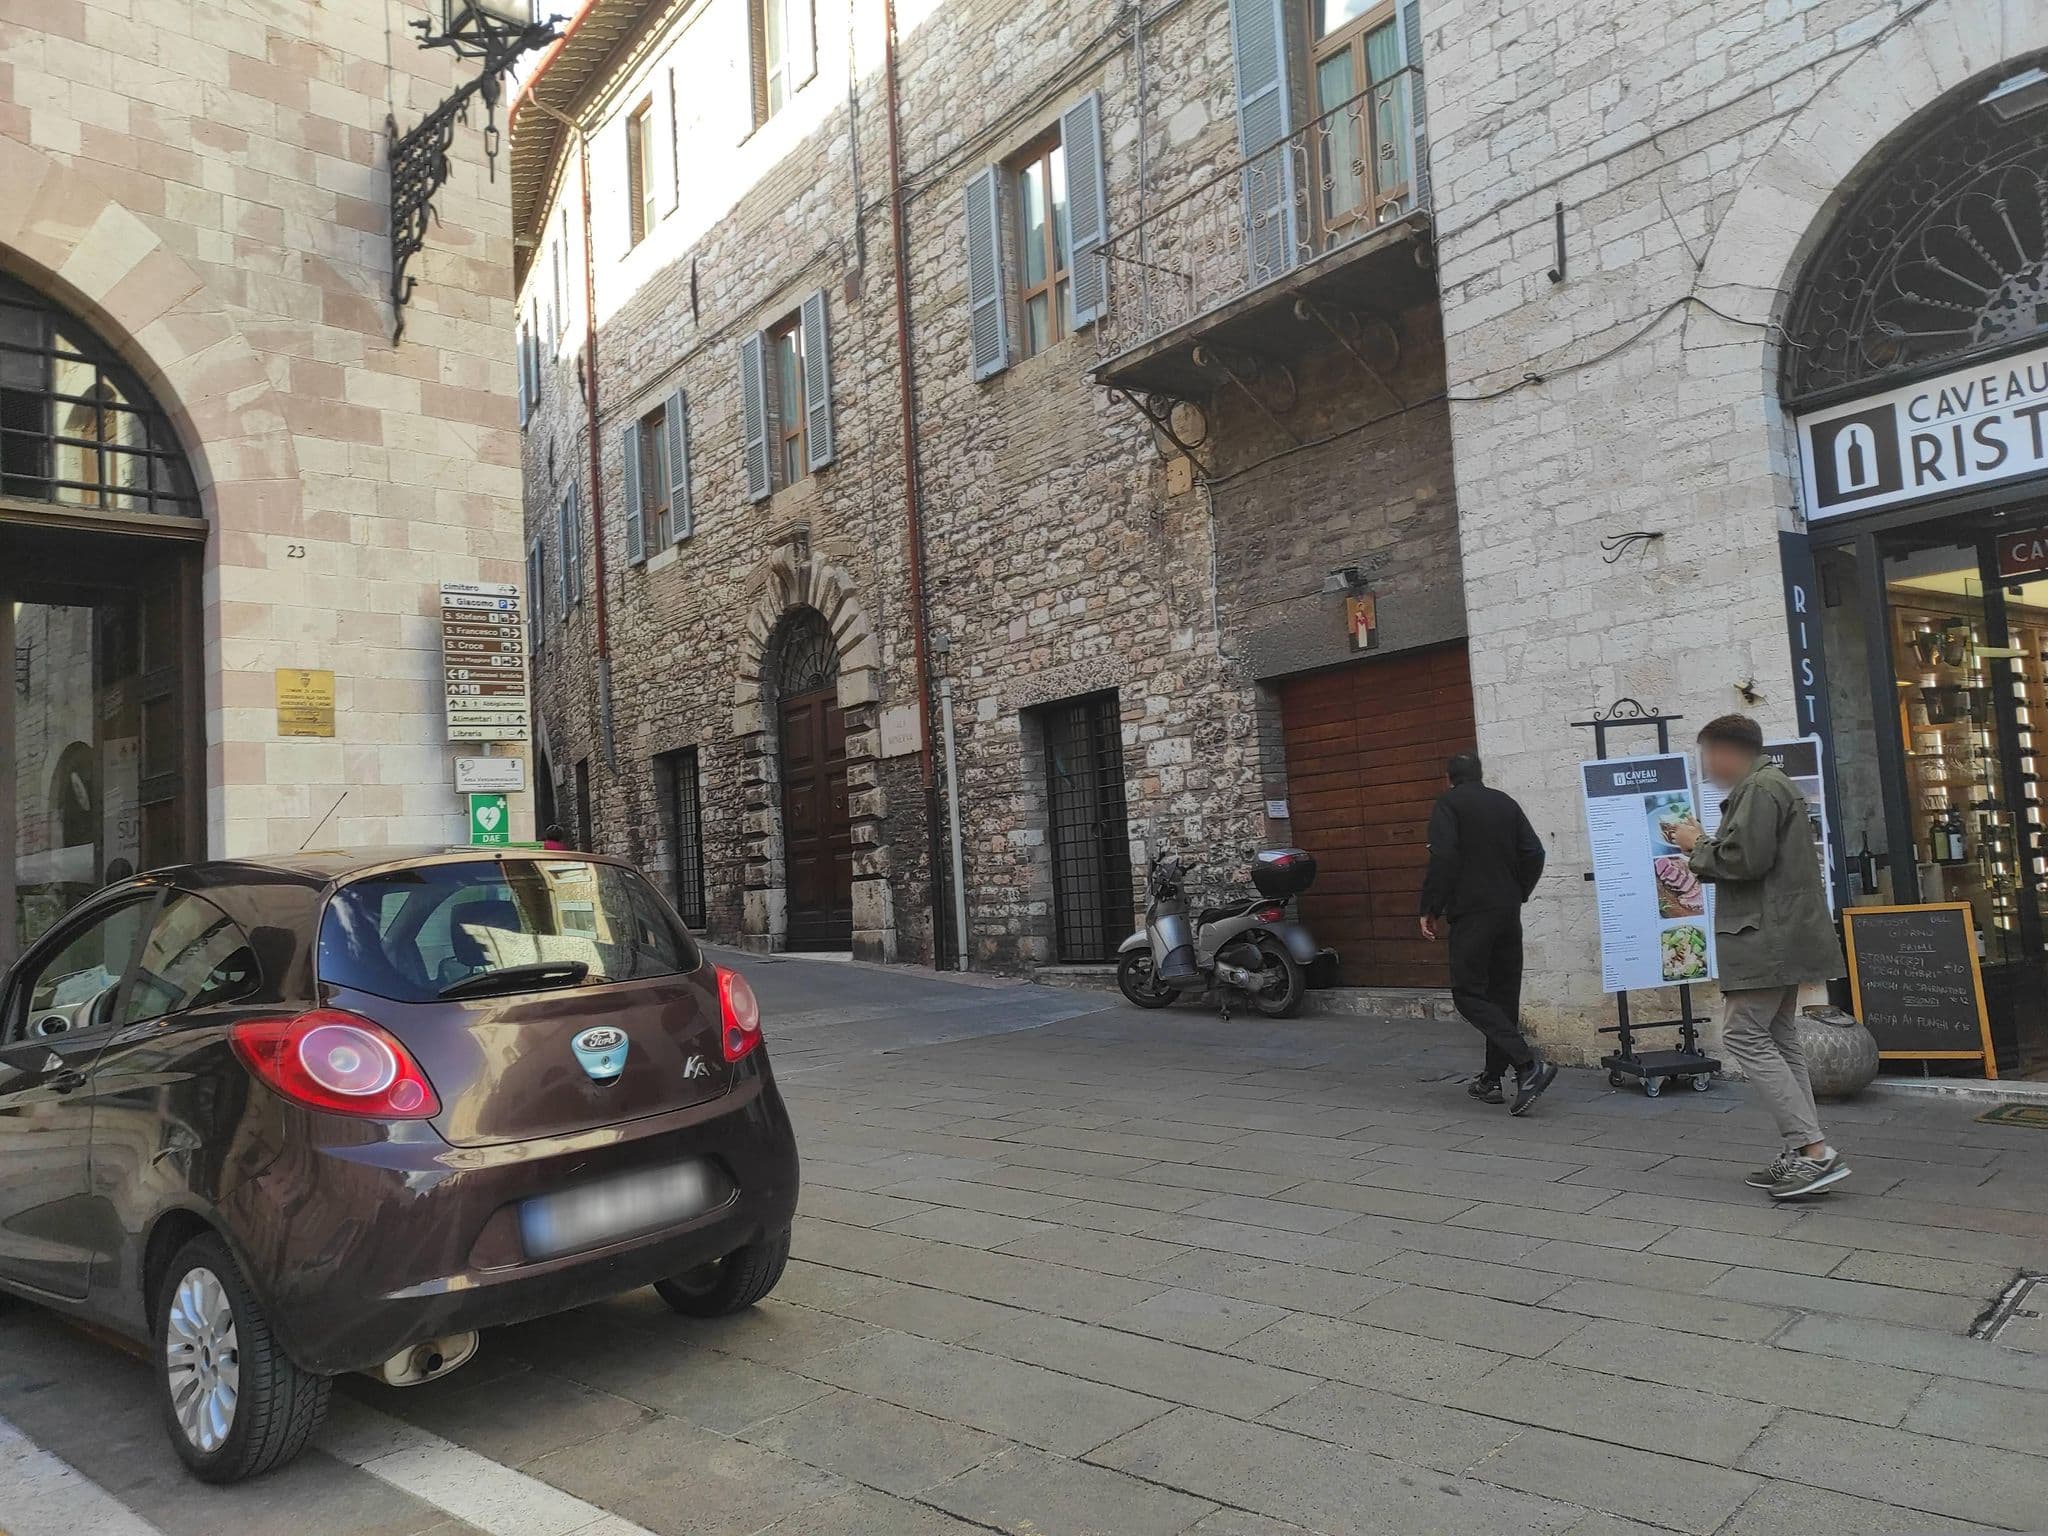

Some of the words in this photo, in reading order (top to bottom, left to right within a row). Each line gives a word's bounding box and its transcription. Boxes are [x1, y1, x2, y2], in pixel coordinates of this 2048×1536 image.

[1908, 362, 2048, 423] CAVEAU
[1911, 403, 2048, 486] RIST
[287, 545, 306, 559] 23
[2012, 539, 2048, 562] CA
[443, 583, 480, 592] cimitero
[456, 598, 494, 607] Giacomo
[444, 612, 453, 620] S.
[455, 612, 487, 621] Stefano
[446, 626, 455, 634] S.
[456, 627, 498, 636] Francesco
[447, 641, 456, 649] S.
[458, 641, 484, 650] Croce
[1626, 769, 1657, 780] CAVEAU
[482, 835, 501, 843] DAE
[589, 1031, 616, 1047] Ford
